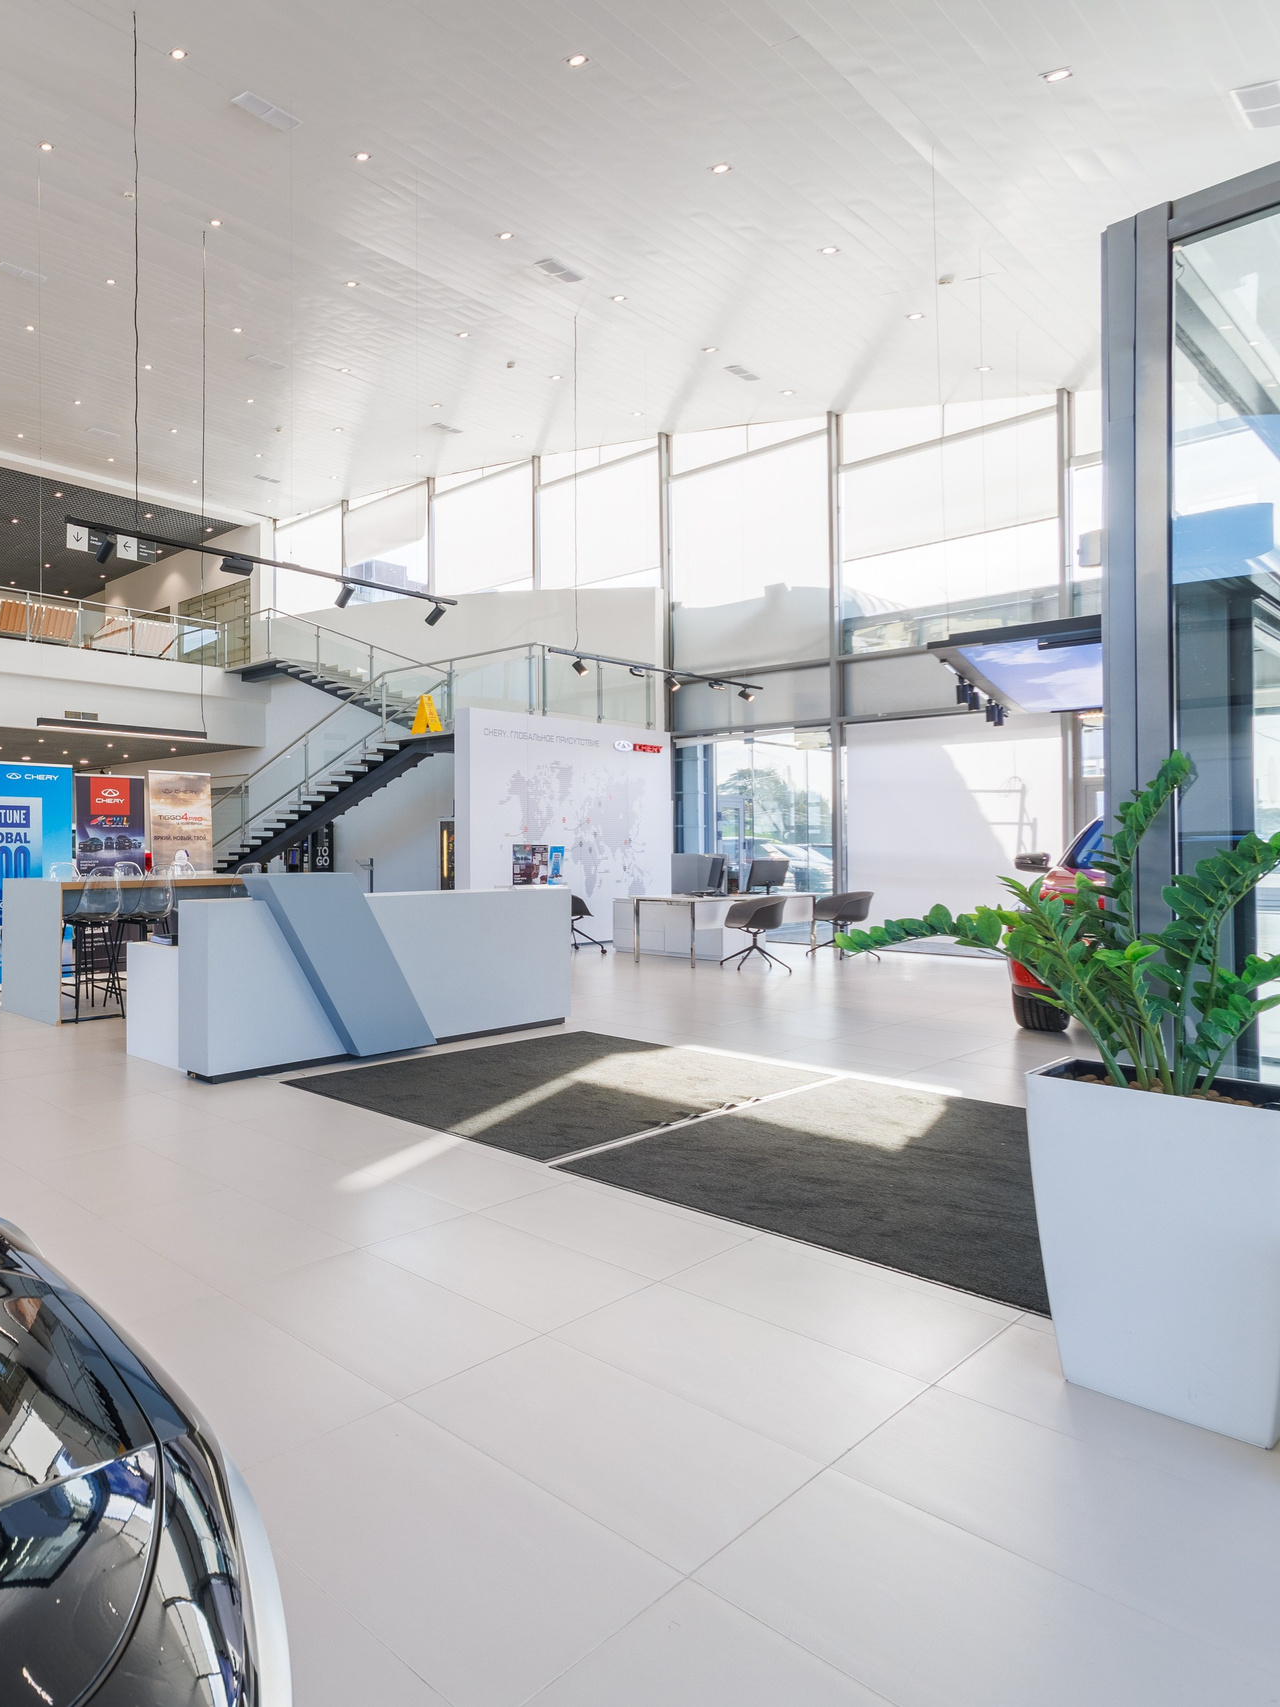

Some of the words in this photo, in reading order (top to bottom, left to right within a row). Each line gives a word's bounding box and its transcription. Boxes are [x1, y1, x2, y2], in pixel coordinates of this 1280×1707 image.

[510, 730, 554, 743] ГЛОБАЛЬНОЕ
[556, 735, 600, 747] ПРИСУТСТВИЕ
[24, 773, 59, 781] CHERY
[316, 846, 329, 856] TO
[316, 856, 330, 866] GO
